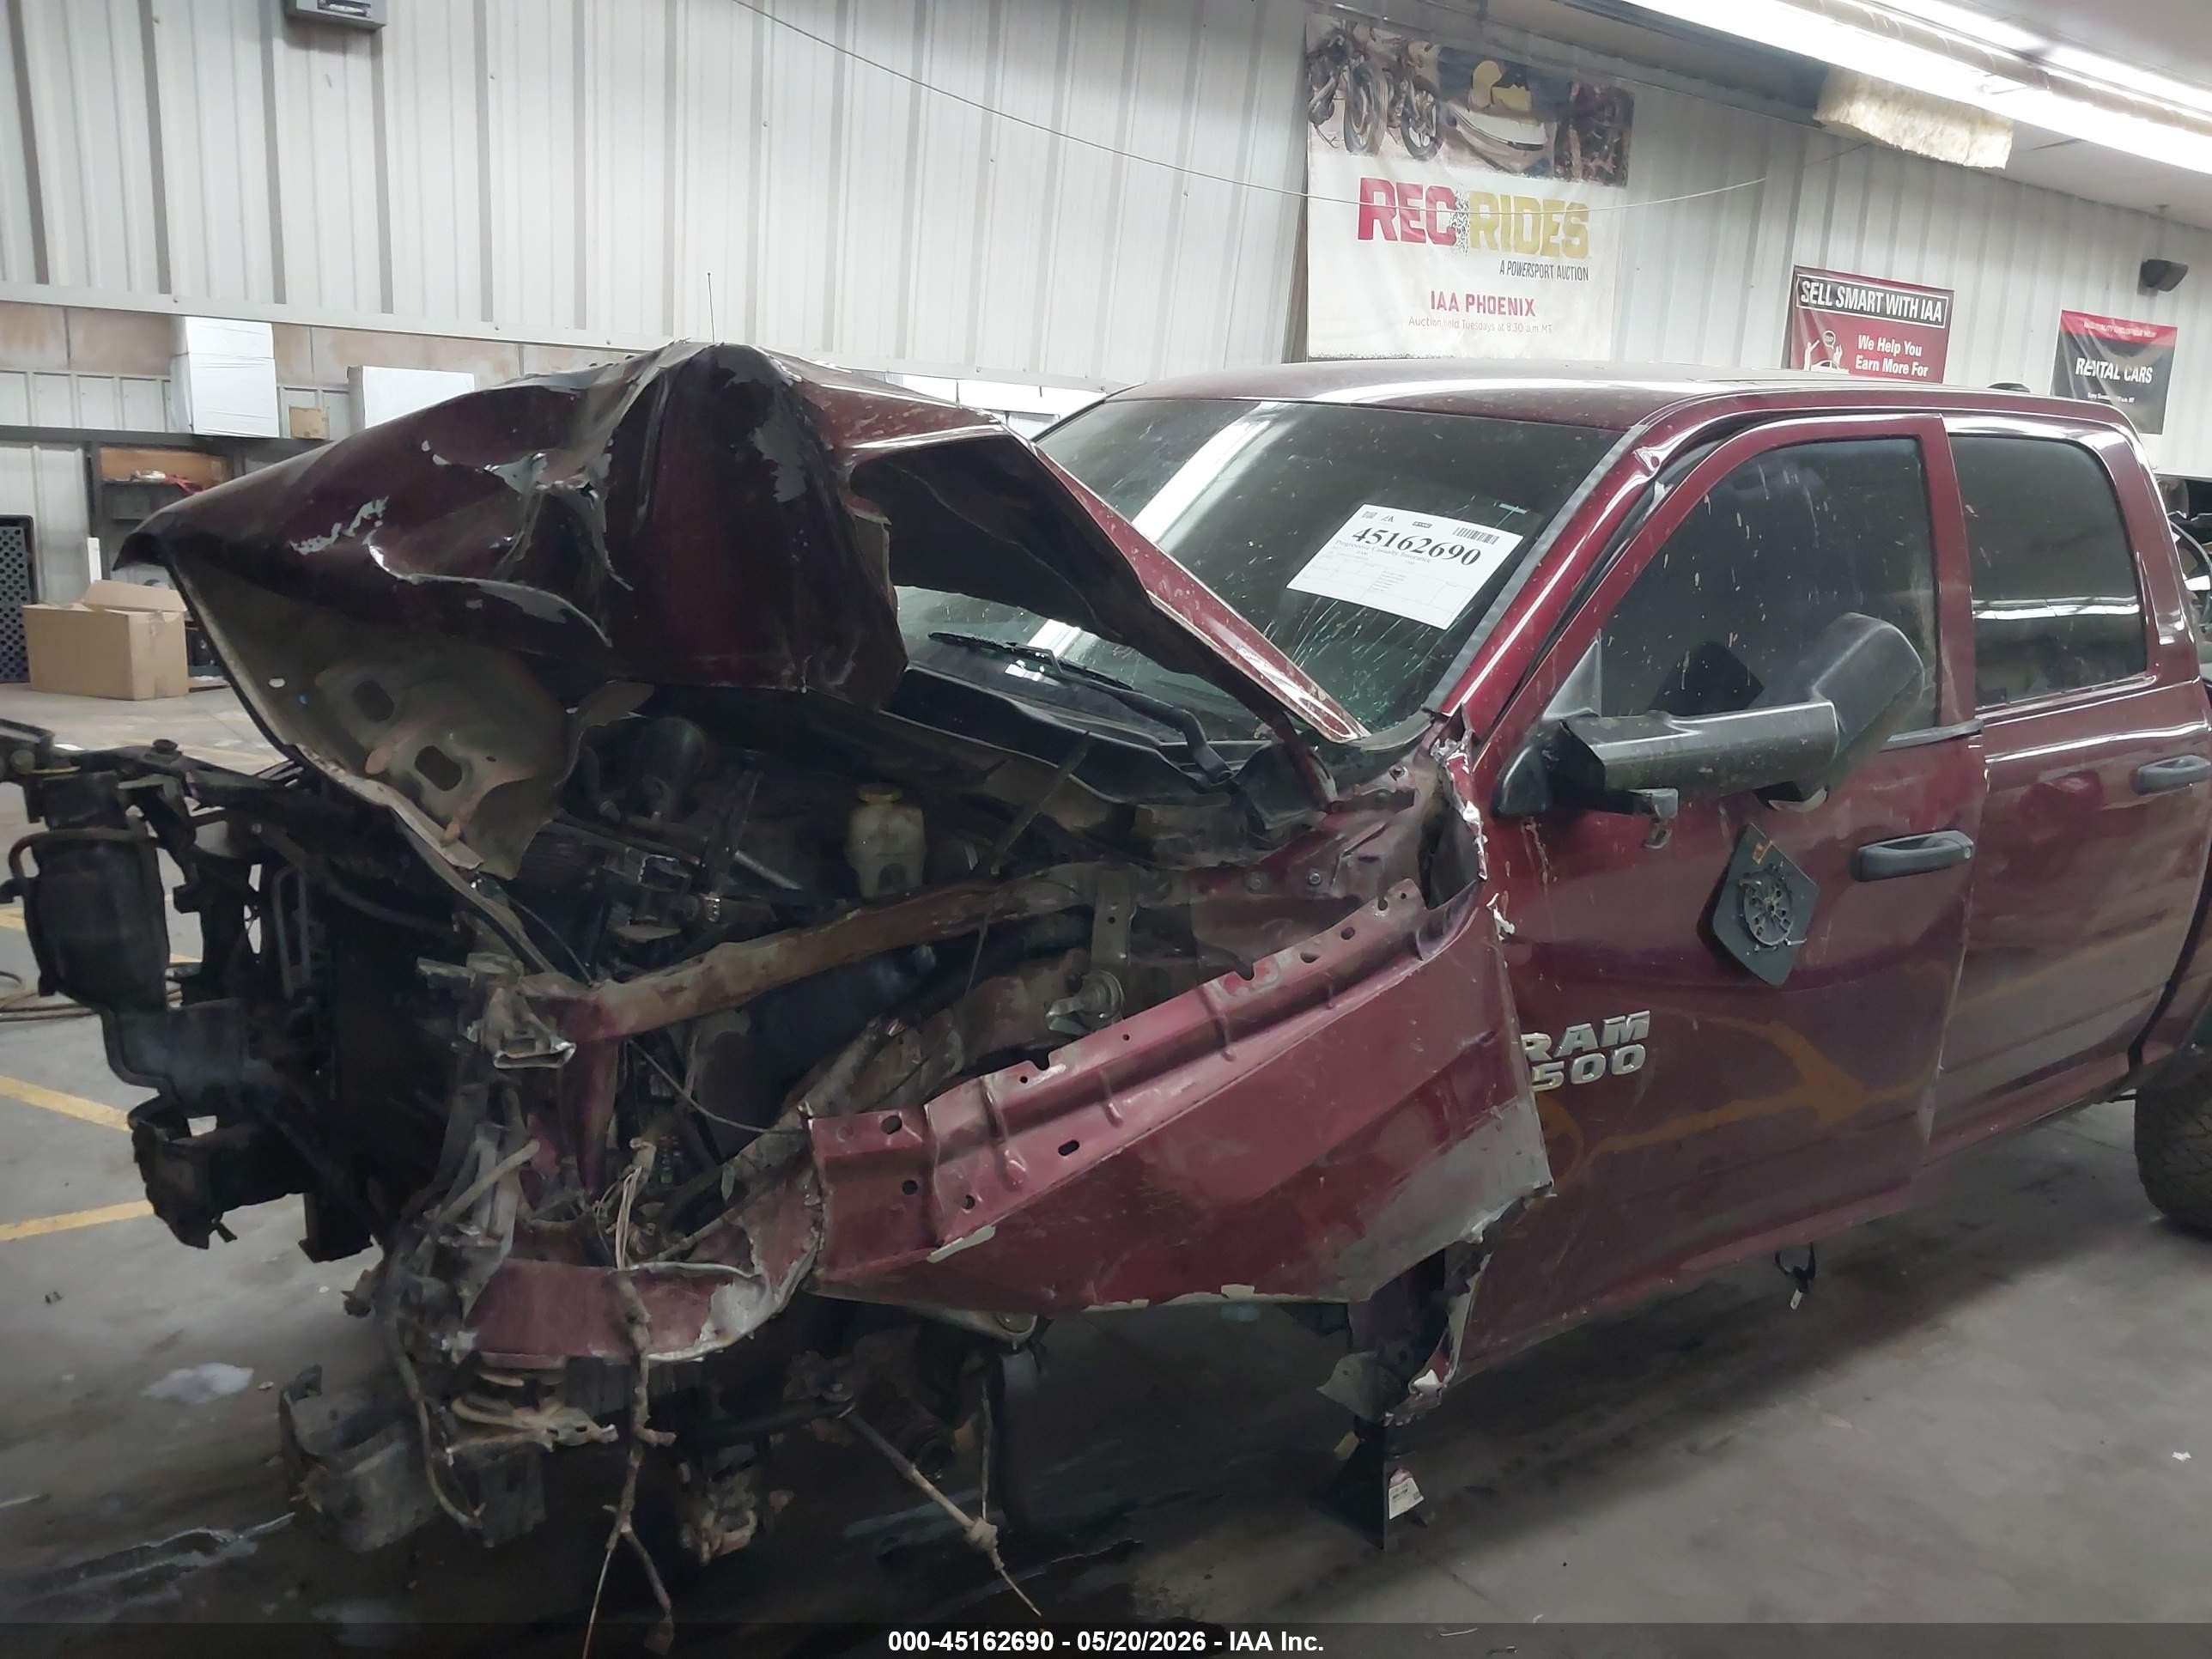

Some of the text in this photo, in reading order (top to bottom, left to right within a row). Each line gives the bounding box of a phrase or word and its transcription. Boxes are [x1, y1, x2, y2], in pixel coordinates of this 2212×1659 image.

[1358, 177, 1590, 259] REC RIDES
[1499, 259, 1589, 282] A POWERSPORT AUCTION
[1430, 290, 1536, 317] IAA PHOENIX
[1801, 280, 1942, 323] SELL SMART WITH IAA
[1462, 319, 1495, 333] Tuesdays
[1857, 334, 1923, 358] We Help You
[1855, 356, 1929, 378] Earn More For
[2075, 357, 2154, 384] RENTAL CARS
[1352, 527, 1482, 566] 45162690
[1521, 1011, 1650, 1061] RAM
